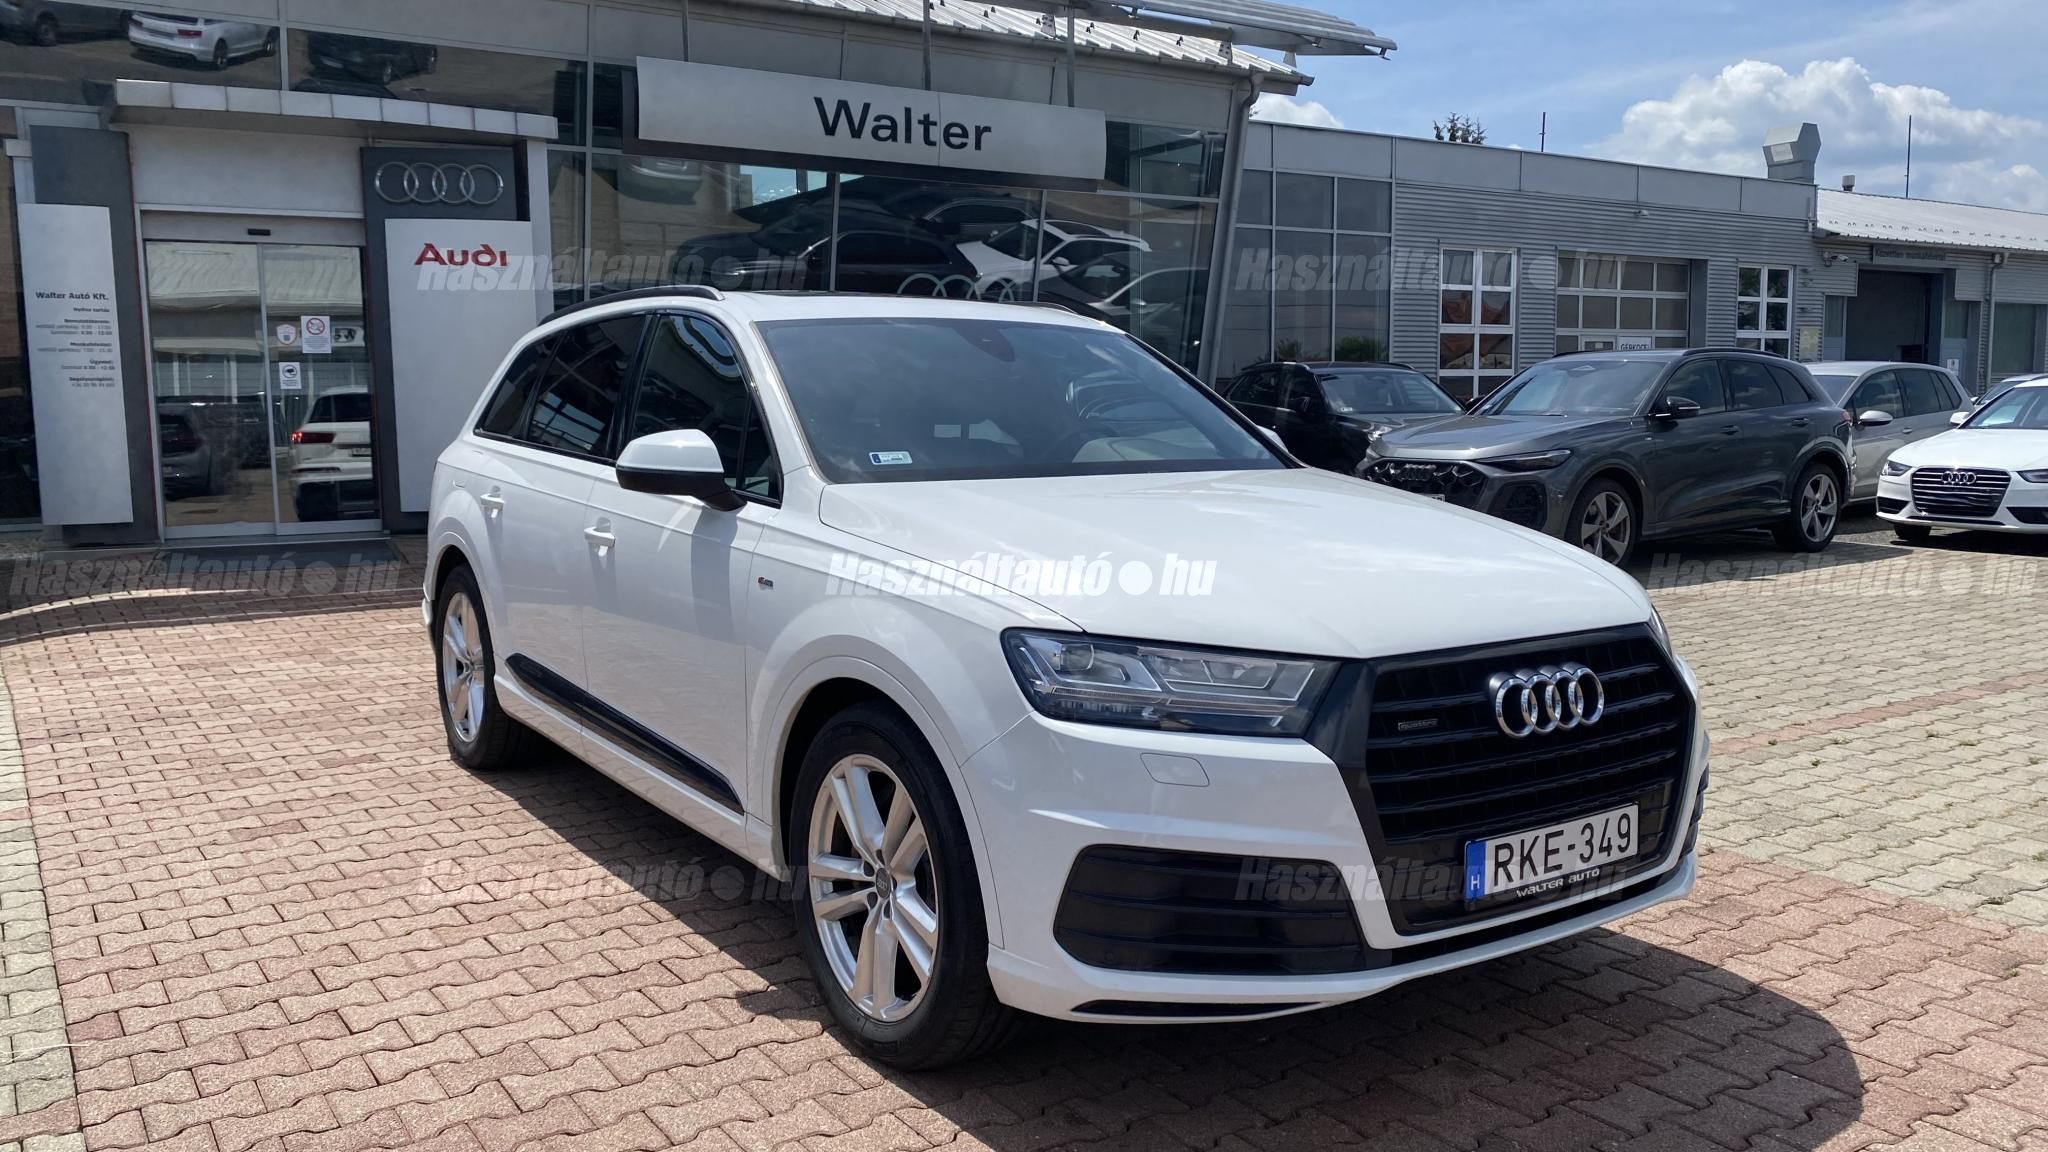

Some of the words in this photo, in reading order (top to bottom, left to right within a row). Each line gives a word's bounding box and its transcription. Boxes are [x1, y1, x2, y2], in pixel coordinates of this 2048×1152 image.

[813, 96, 992, 152] Walter
[414, 243, 509, 267] Audi
[35, 292, 66, 300] Walter
[69, 291, 91, 300] Autó
[93, 293, 109, 301] Kft.
[1492, 812, 1632, 887] RKE-349
[1470, 874, 1481, 891] H
[1516, 877, 1564, 898] WALTER
